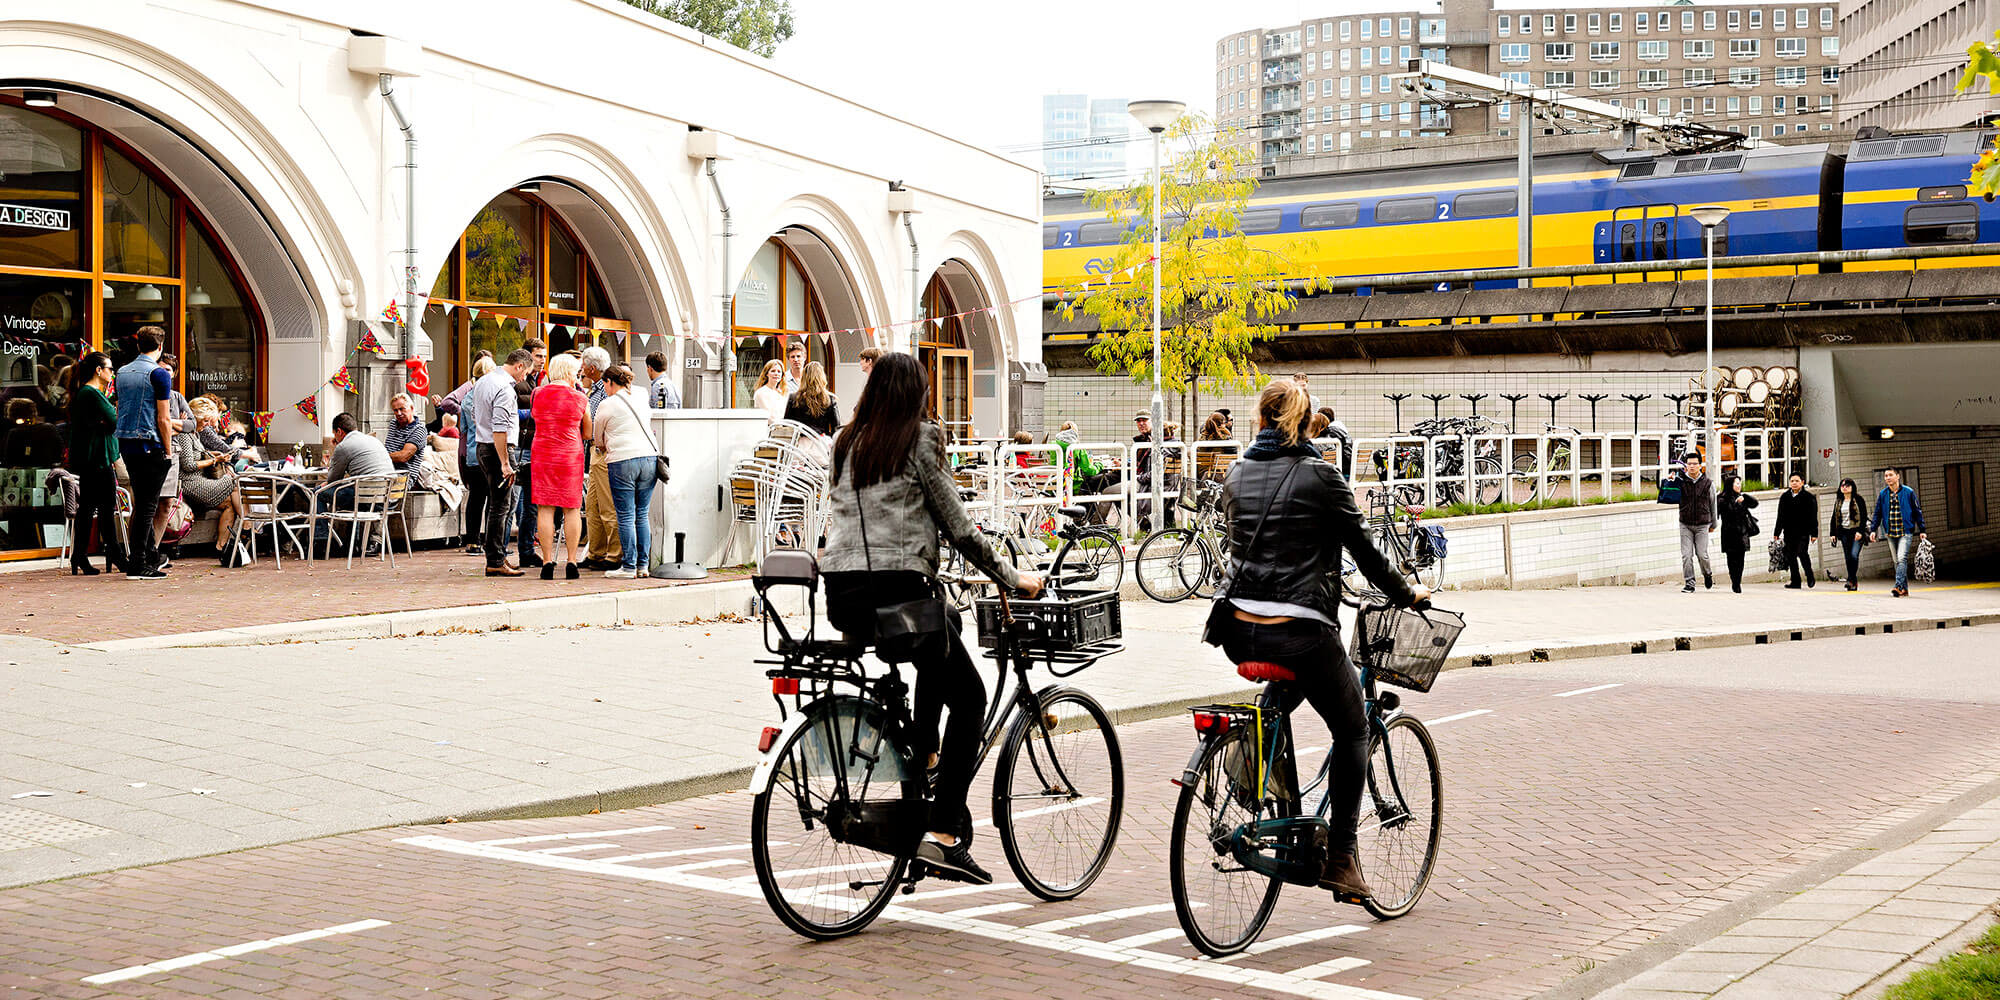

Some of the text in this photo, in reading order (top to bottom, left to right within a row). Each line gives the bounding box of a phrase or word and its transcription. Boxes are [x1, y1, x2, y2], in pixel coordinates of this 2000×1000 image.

[15, 208, 64, 227] DESIGN
[1438, 203, 1450, 220] 2
[1063, 231, 1073, 247] 2
[1600, 228, 1606, 236] 2
[1600, 249, 1606, 257] 2
[3, 314, 47, 334] Vintage
[3, 340, 40, 360] Design
